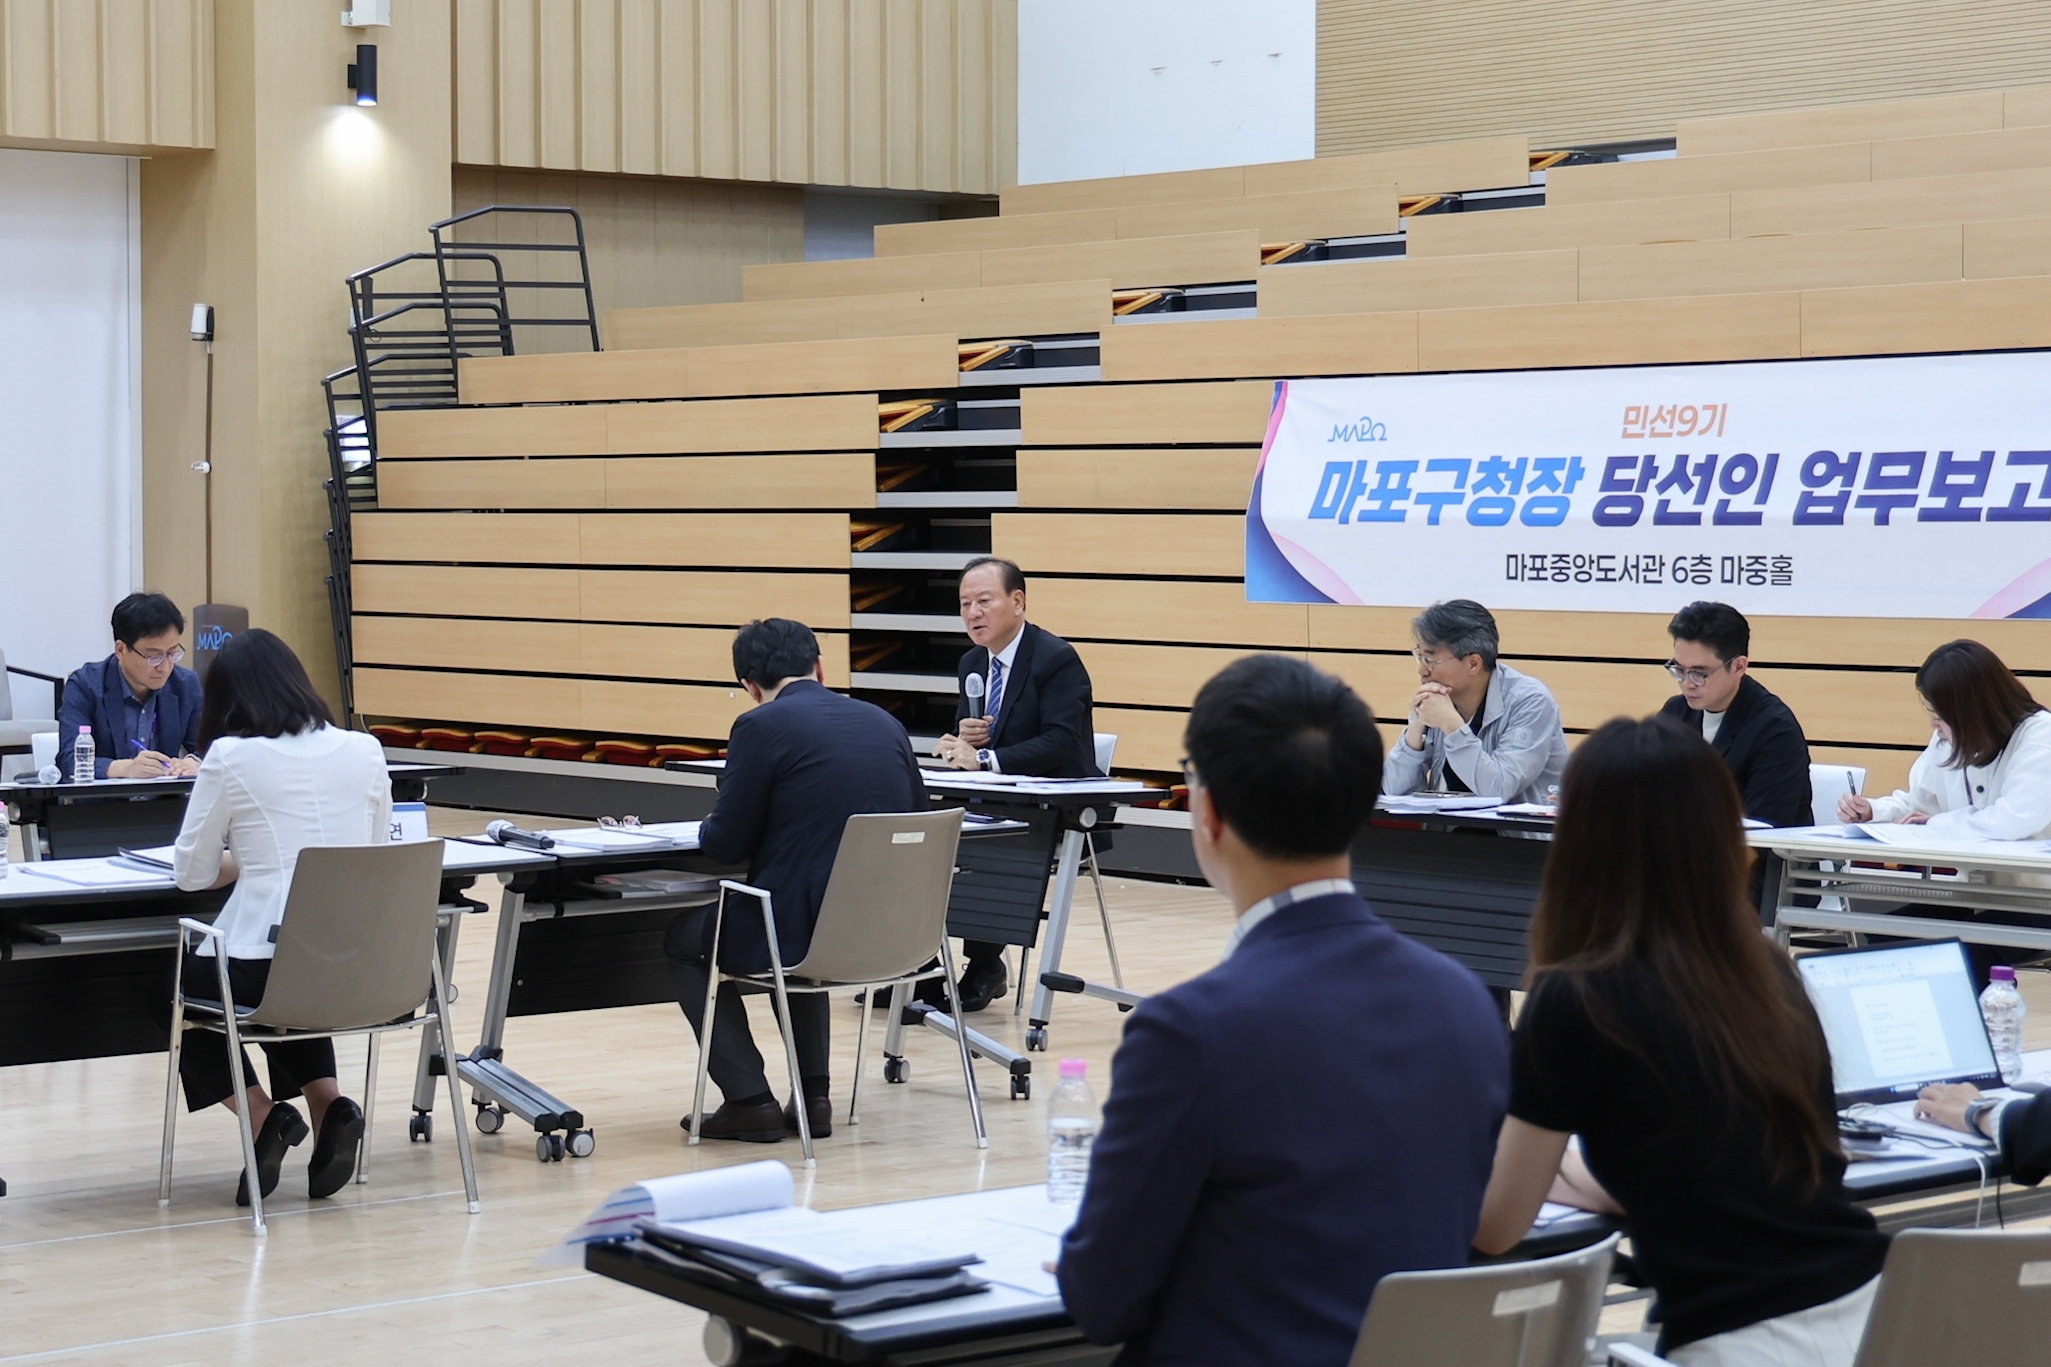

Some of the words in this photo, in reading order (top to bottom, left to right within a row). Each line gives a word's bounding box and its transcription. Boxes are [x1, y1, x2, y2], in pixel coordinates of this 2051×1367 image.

[1621, 403, 1728, 439] 민선9기
[1308, 455, 1586, 527] 마포구청장
[1592, 453, 1780, 527] 당선인
[1792, 450, 2051, 526] 업무보고
[1505, 553, 1666, 585] 마포중앙도서관
[1671, 555, 1713, 585] 6층
[1720, 554, 1794, 586] 마중홀
